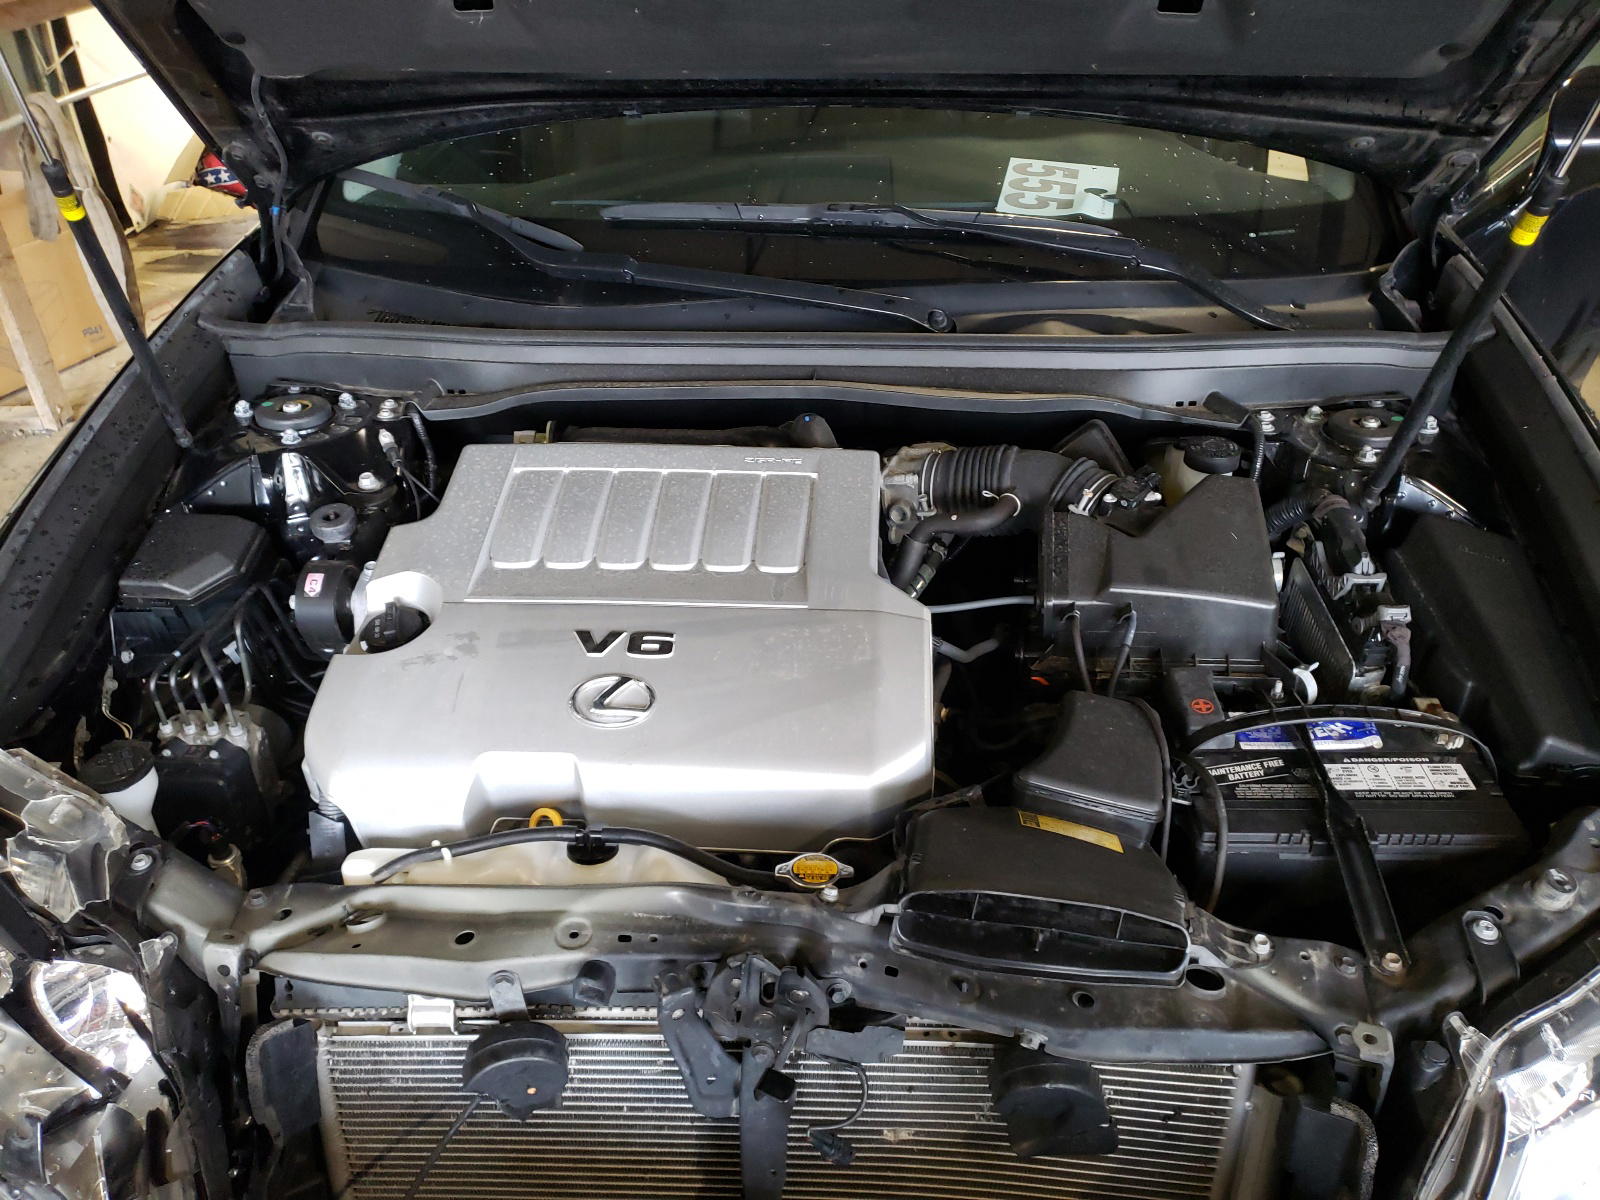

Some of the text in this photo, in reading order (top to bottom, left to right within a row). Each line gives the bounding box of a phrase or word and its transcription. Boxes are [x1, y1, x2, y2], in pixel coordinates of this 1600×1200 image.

[1004, 163, 1079, 210] 555
[573, 630, 676, 659] V6
[1262, 759, 1285, 769] FREE
[1228, 769, 1265, 781] BATTERY
